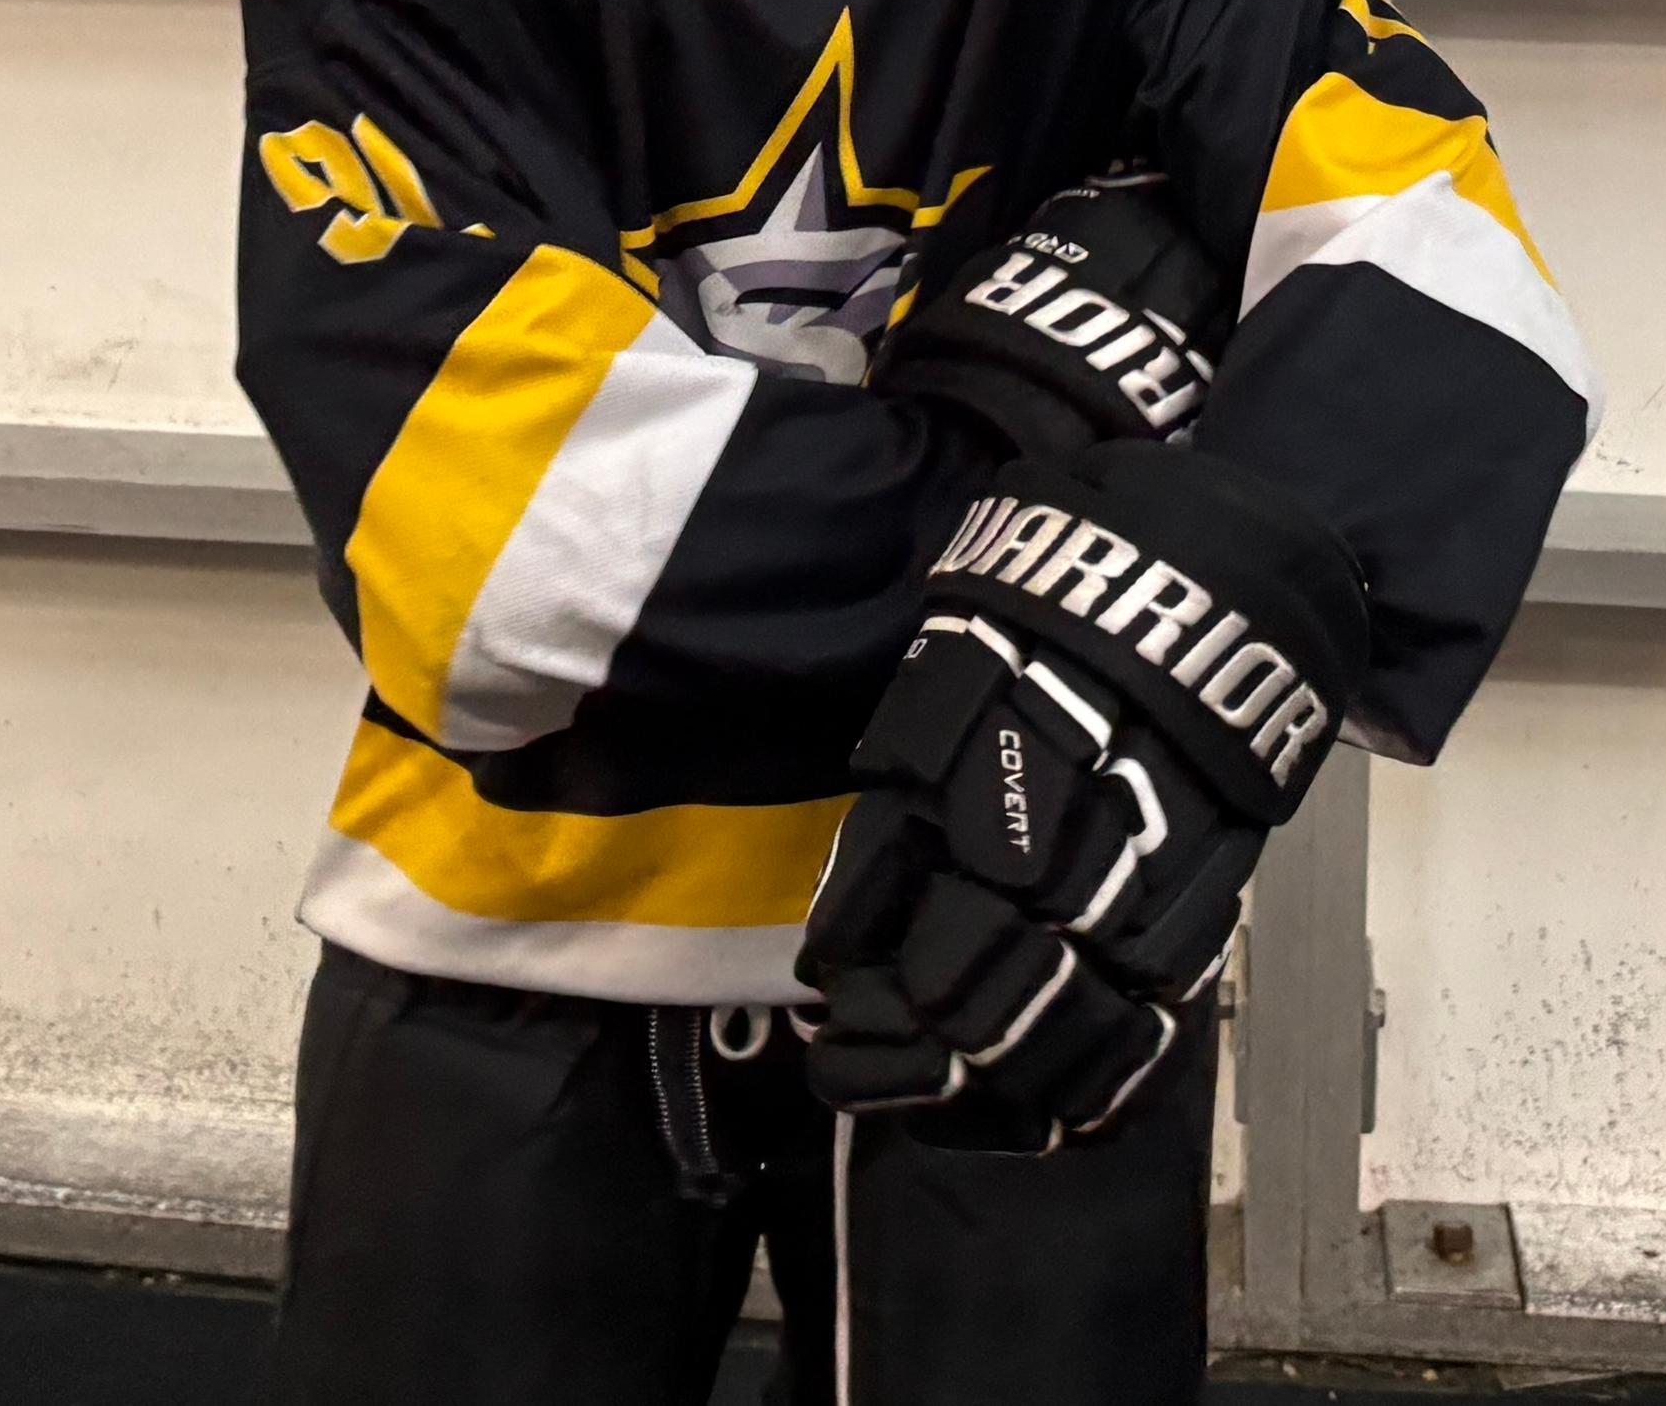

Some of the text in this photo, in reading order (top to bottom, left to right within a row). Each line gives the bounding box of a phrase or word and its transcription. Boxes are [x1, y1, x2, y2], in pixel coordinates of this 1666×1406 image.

[964, 251, 1199, 430] RIOR
[927, 496, 1329, 790] WARRIOR
[998, 729, 1031, 854] COVERT
